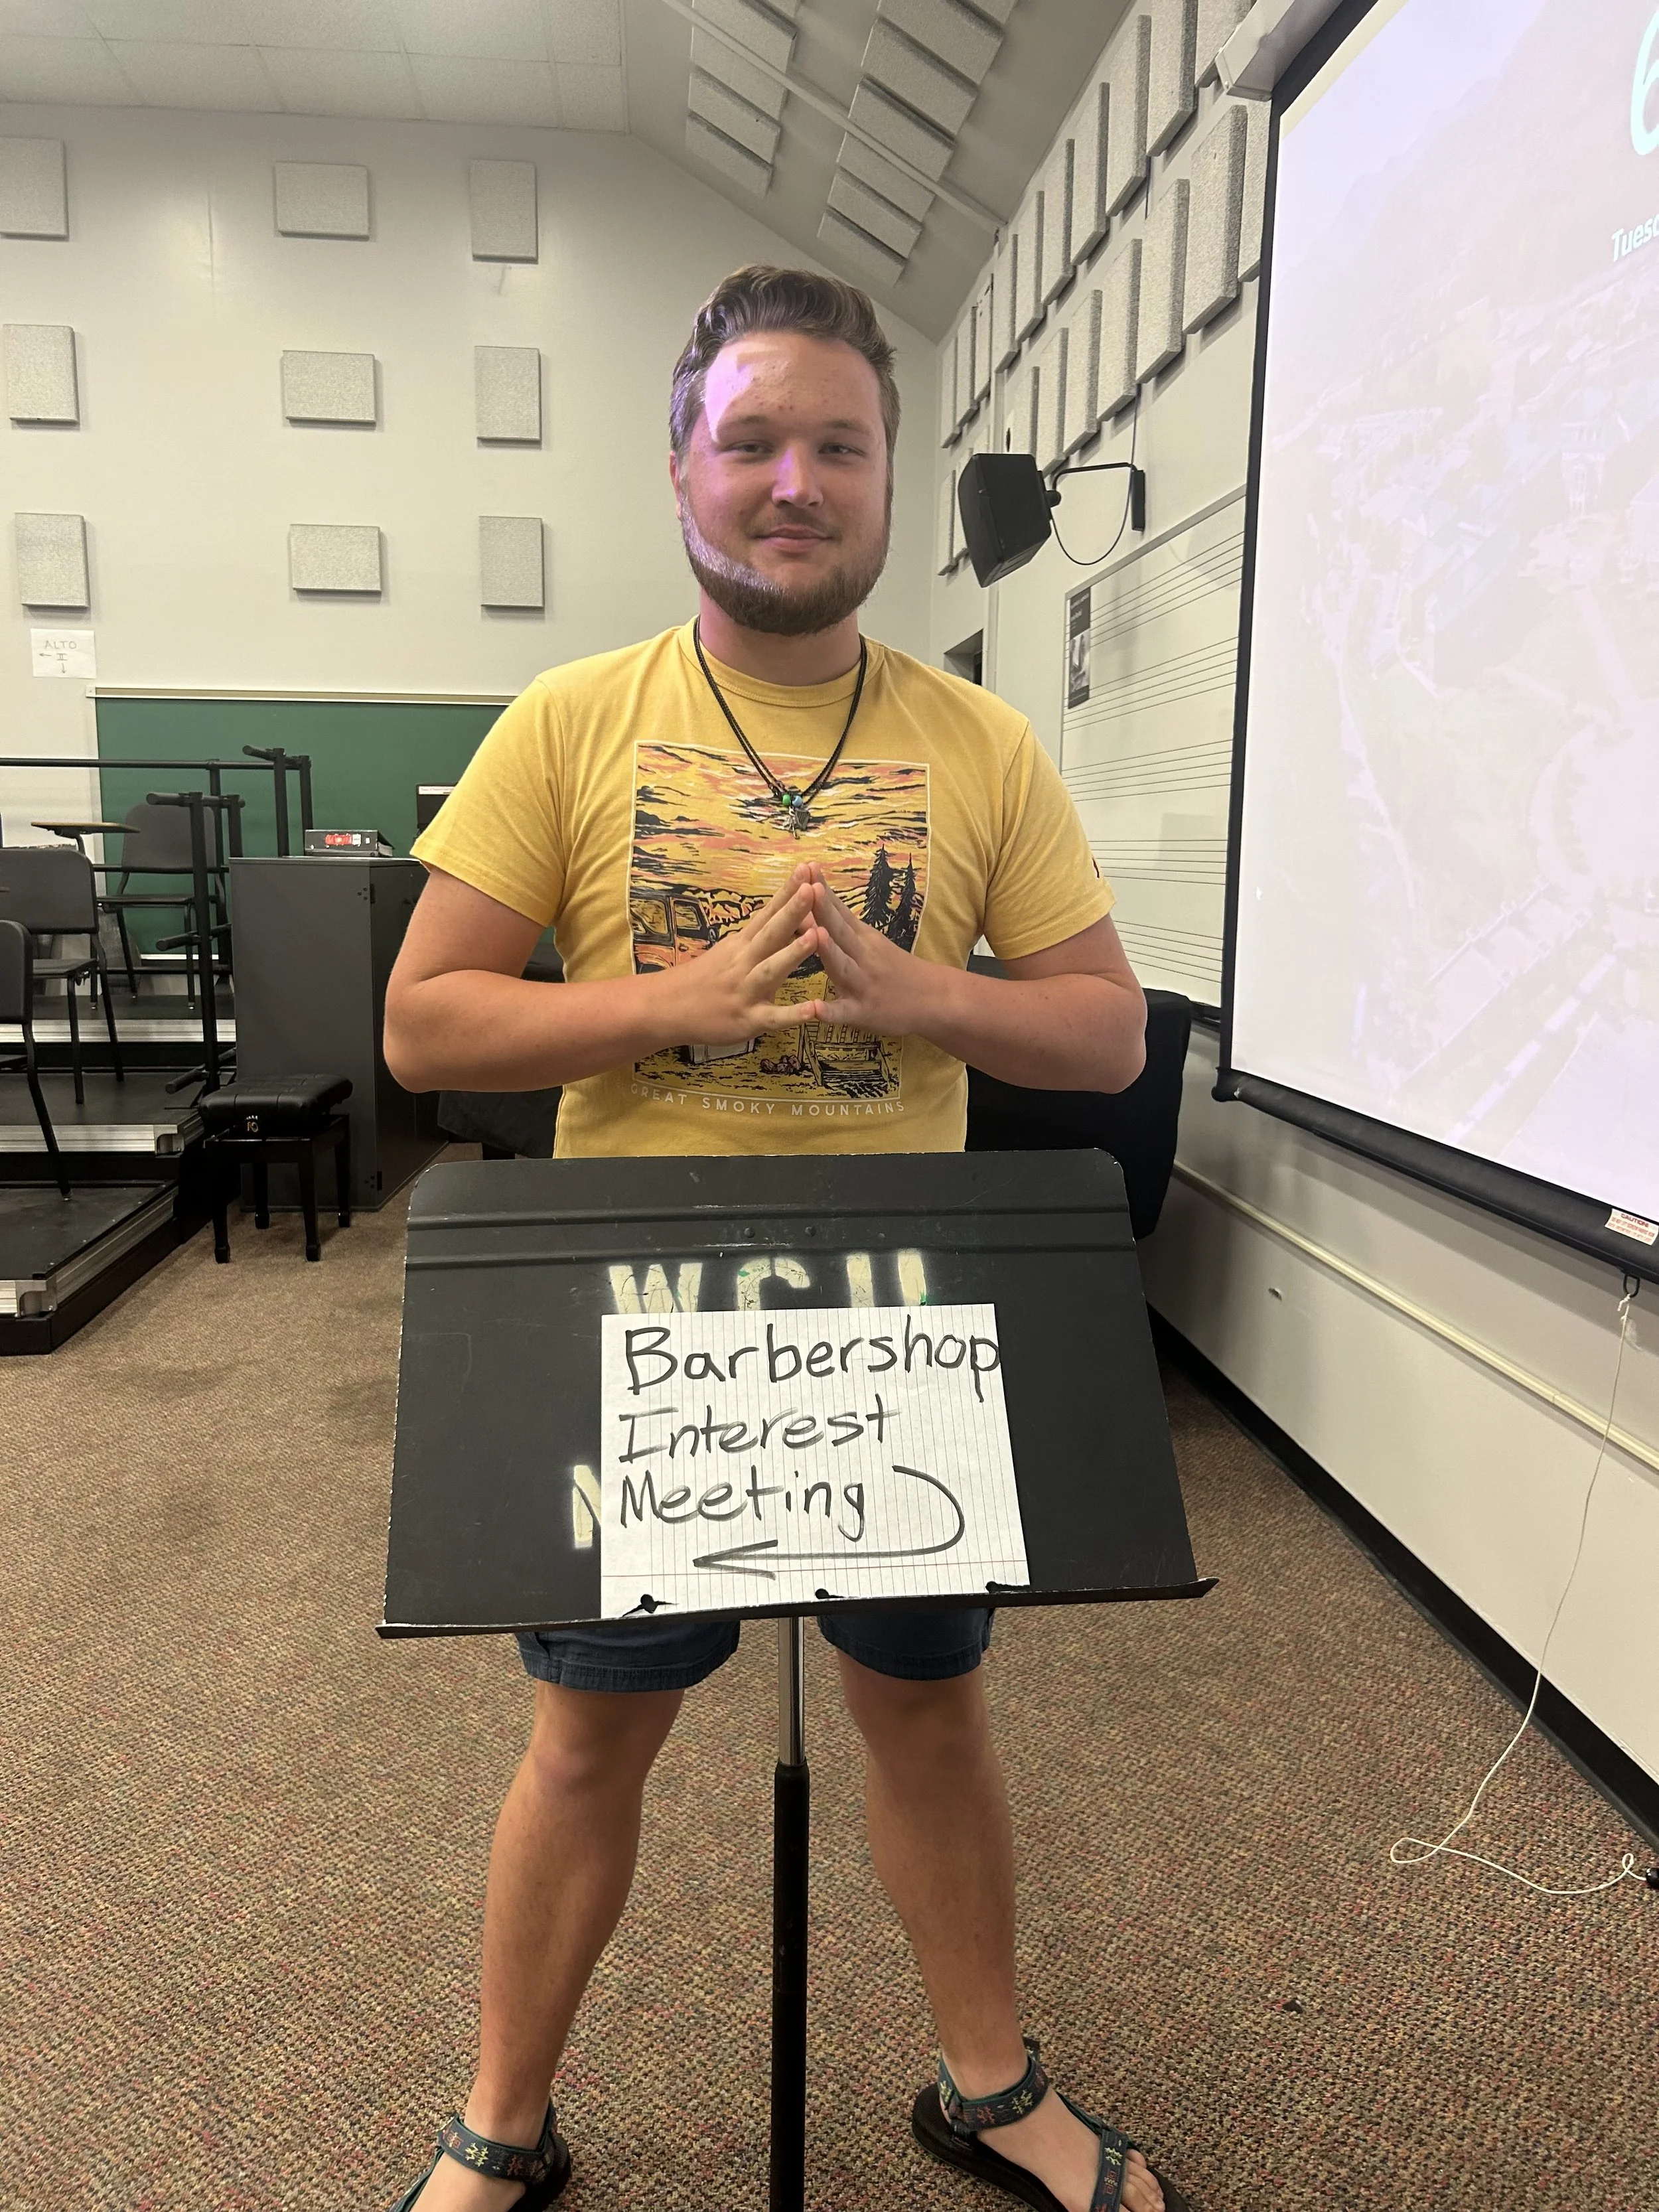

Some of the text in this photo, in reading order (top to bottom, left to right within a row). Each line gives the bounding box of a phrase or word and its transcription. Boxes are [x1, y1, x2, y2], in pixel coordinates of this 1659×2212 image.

[44, 640, 77, 650] ALTO
[630, 1082, 905, 1116] GREAT SMOKY MOUNTAINS
[624, 1314, 1001, 1402] Barbershop
[618, 1393, 902, 1463] Interest
[619, 1465, 864, 1542] Meeting
